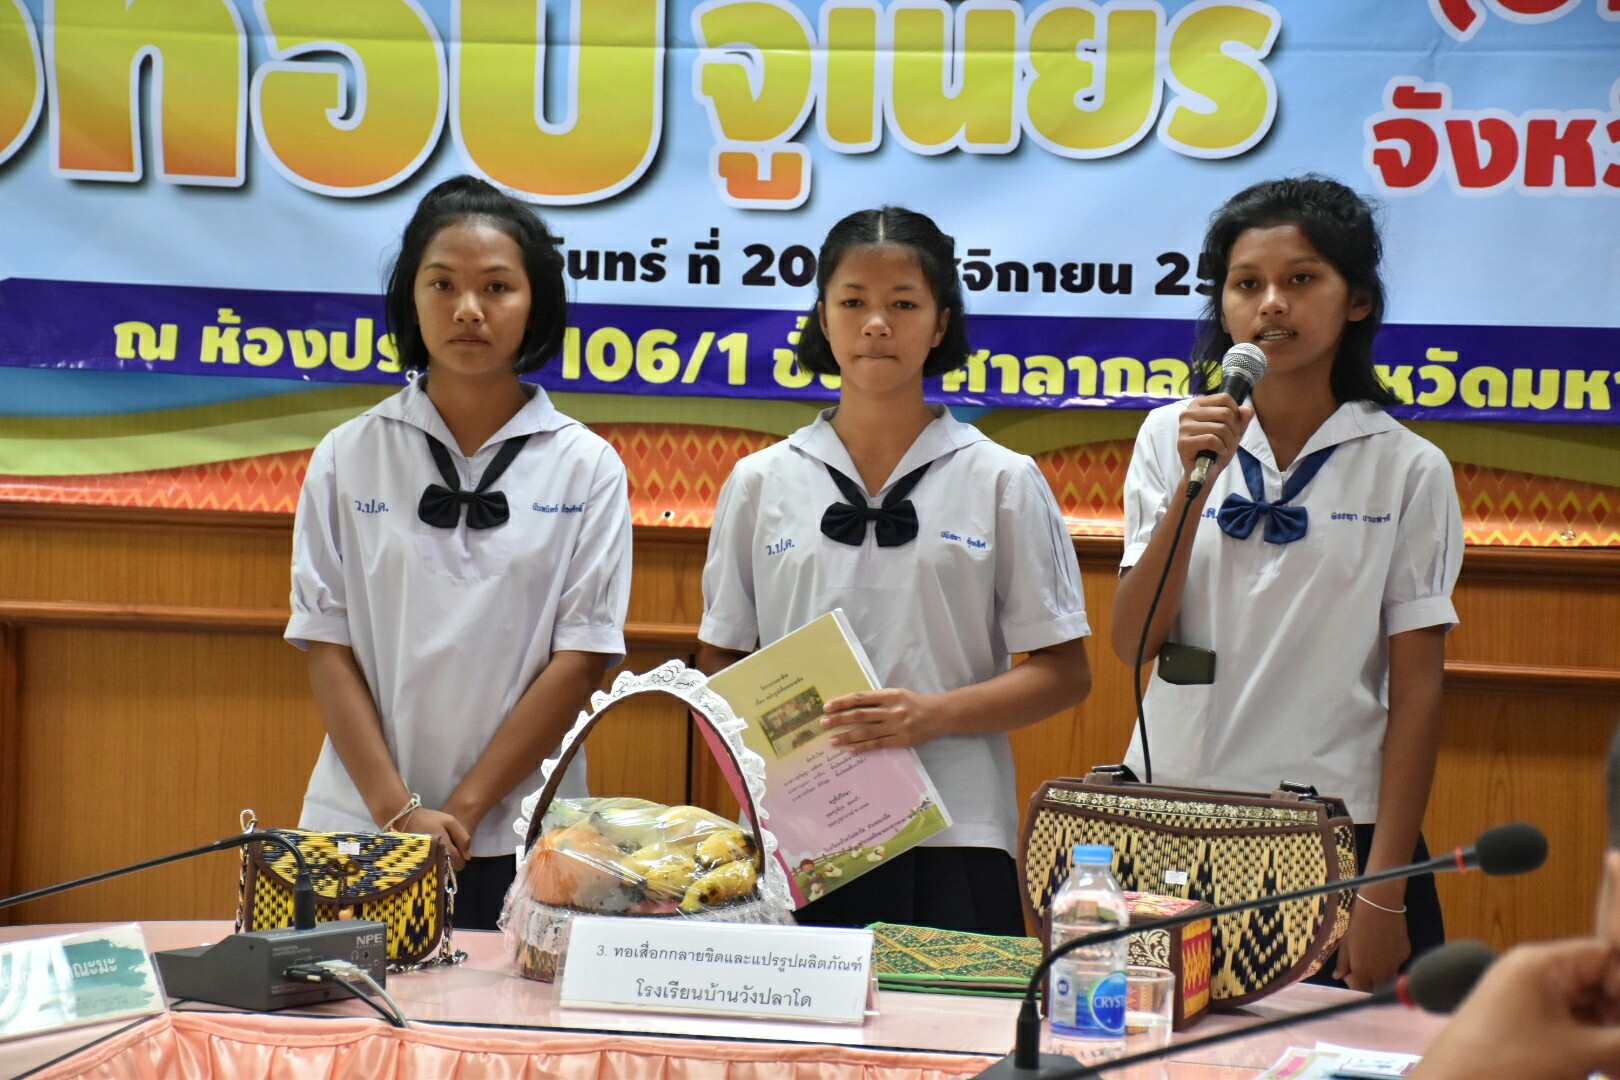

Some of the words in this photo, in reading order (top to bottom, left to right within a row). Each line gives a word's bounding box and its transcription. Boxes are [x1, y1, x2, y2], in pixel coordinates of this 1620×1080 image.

[114, 321, 178, 361] ณ
[355, 933, 383, 946] NPE
[596, 945, 608, 957] 3.
[613, 941, 862, 972] ทอเสื่อกกลายขิดและแปรรูปผลิตภัณฑ์
[636, 978, 812, 1008] โรงเรียนบ้านวังปลาโด
